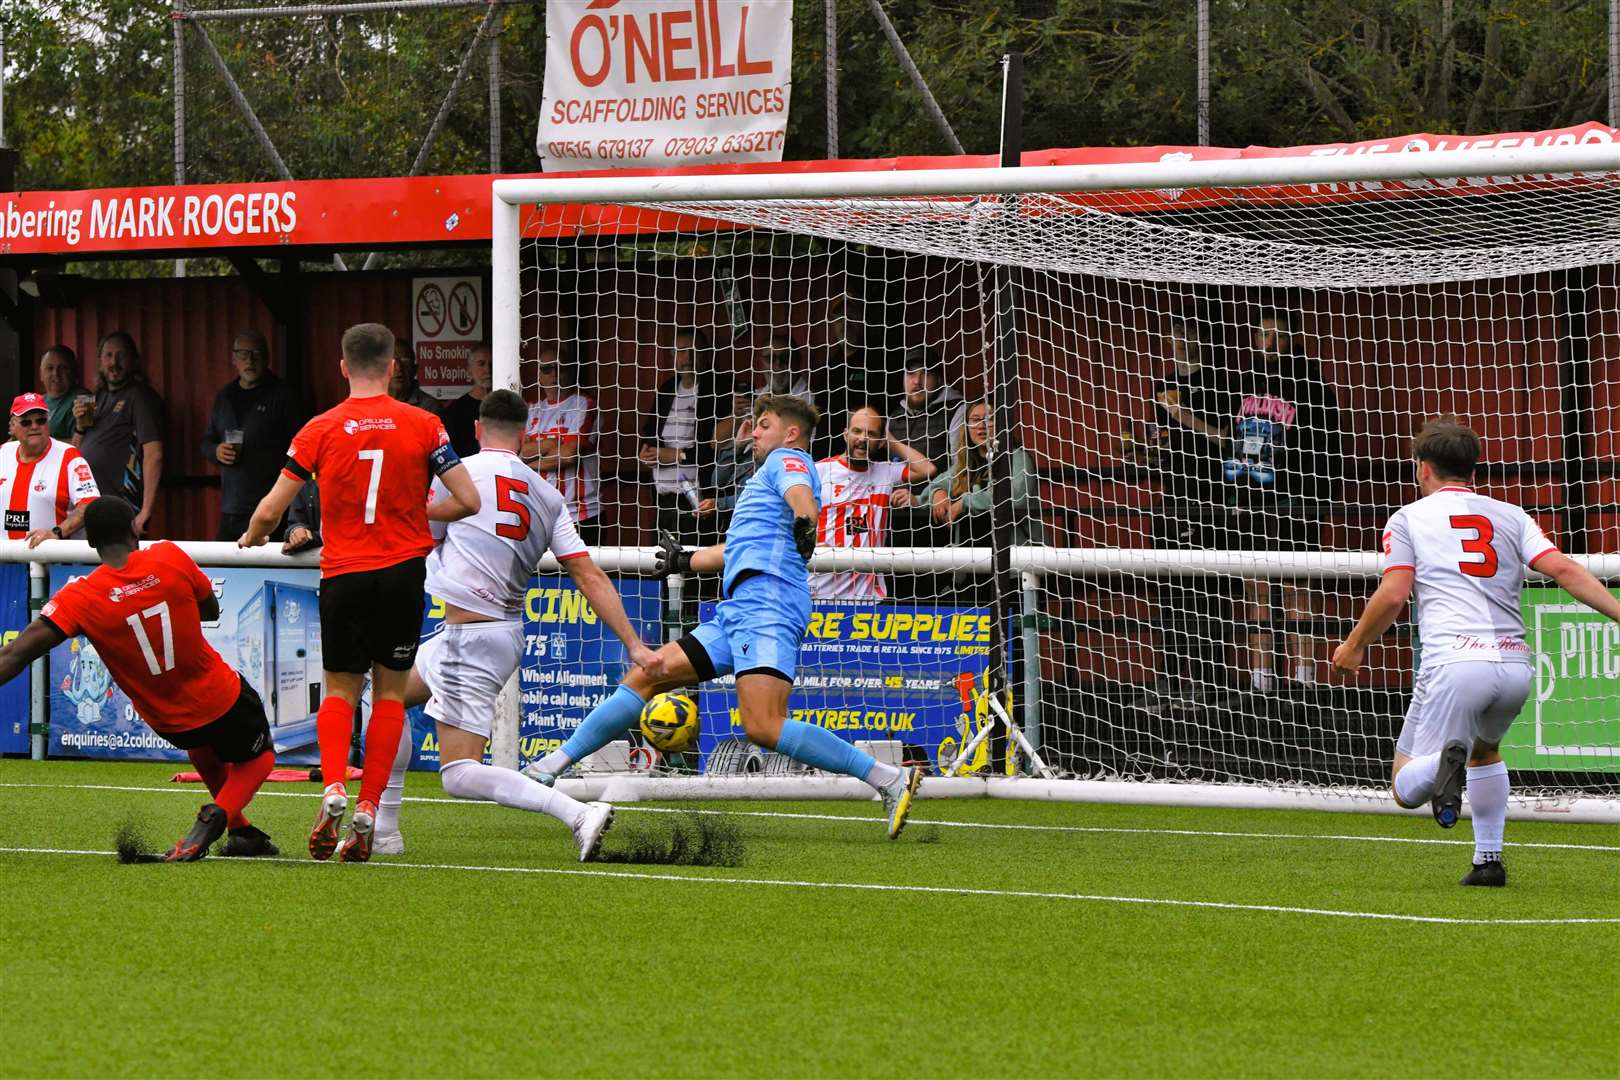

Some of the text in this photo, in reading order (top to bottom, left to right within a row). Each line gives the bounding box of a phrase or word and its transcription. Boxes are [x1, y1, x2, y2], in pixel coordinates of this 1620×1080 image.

[551, 87, 784, 124] SCAFFOLDING SERVICES
[548, 140, 592, 160] 07515
[597, 139, 655, 160] 679137
[664, 136, 718, 157] 07903
[0, 191, 297, 245] bering MARK ROGERS
[420, 345, 472, 360] No Smokin
[424, 366, 438, 380] No
[358, 449, 384, 524] 7
[495, 475, 531, 541] 5
[1449, 514, 1498, 577] 3
[126, 601, 174, 675] 17
[850, 613, 991, 642] SUPPLIES
[802, 645, 844, 653] BATTERIES
[846, 645, 872, 653] TRADE
[881, 646, 908, 654] RETAIL
[911, 646, 932, 655] SINCE
[933, 646, 951, 655] 1975
[521, 670, 608, 687] Wheel Alignment
[803, 677, 827, 687] MILE
[829, 677, 851, 688] FOR
[853, 679, 882, 689] OVER
[885, 676, 904, 688] 45
[905, 680, 941, 690] YEARS
[550, 692, 567, 706] call
[569, 693, 591, 707] outs
[528, 713, 555, 727] Plant
